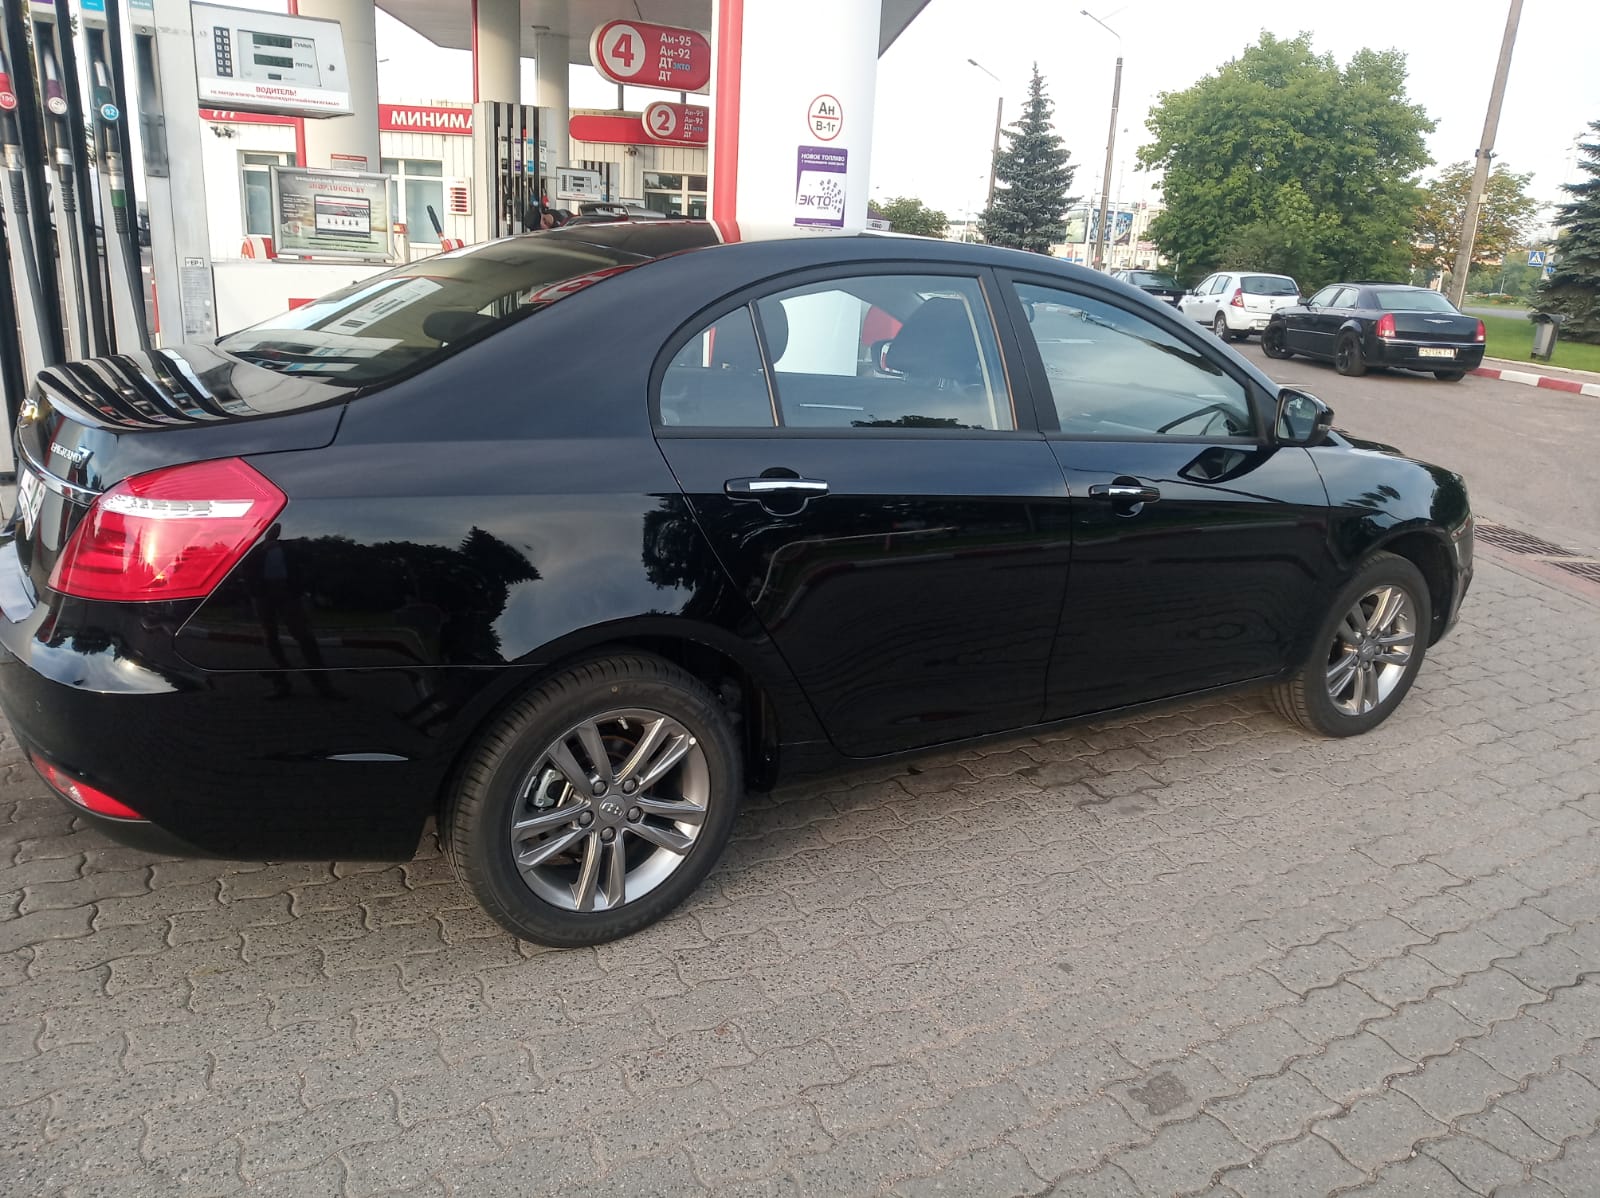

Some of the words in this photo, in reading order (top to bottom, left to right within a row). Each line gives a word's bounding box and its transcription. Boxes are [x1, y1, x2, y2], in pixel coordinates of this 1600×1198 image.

[660, 33, 691, 46] Аи-95
[612, 33, 635, 68] 4
[660, 46, 690, 59] Аи-92
[659, 57, 672, 69] ДТ
[659, 71, 671, 81] ДТ
[255, 86, 297, 97] ВОДИТЕЛЬ!
[818, 102, 835, 115] Ан
[657, 110, 670, 131] 2
[685, 116, 703, 124] Аи-92
[799, 195, 832, 206] ЭКТО
